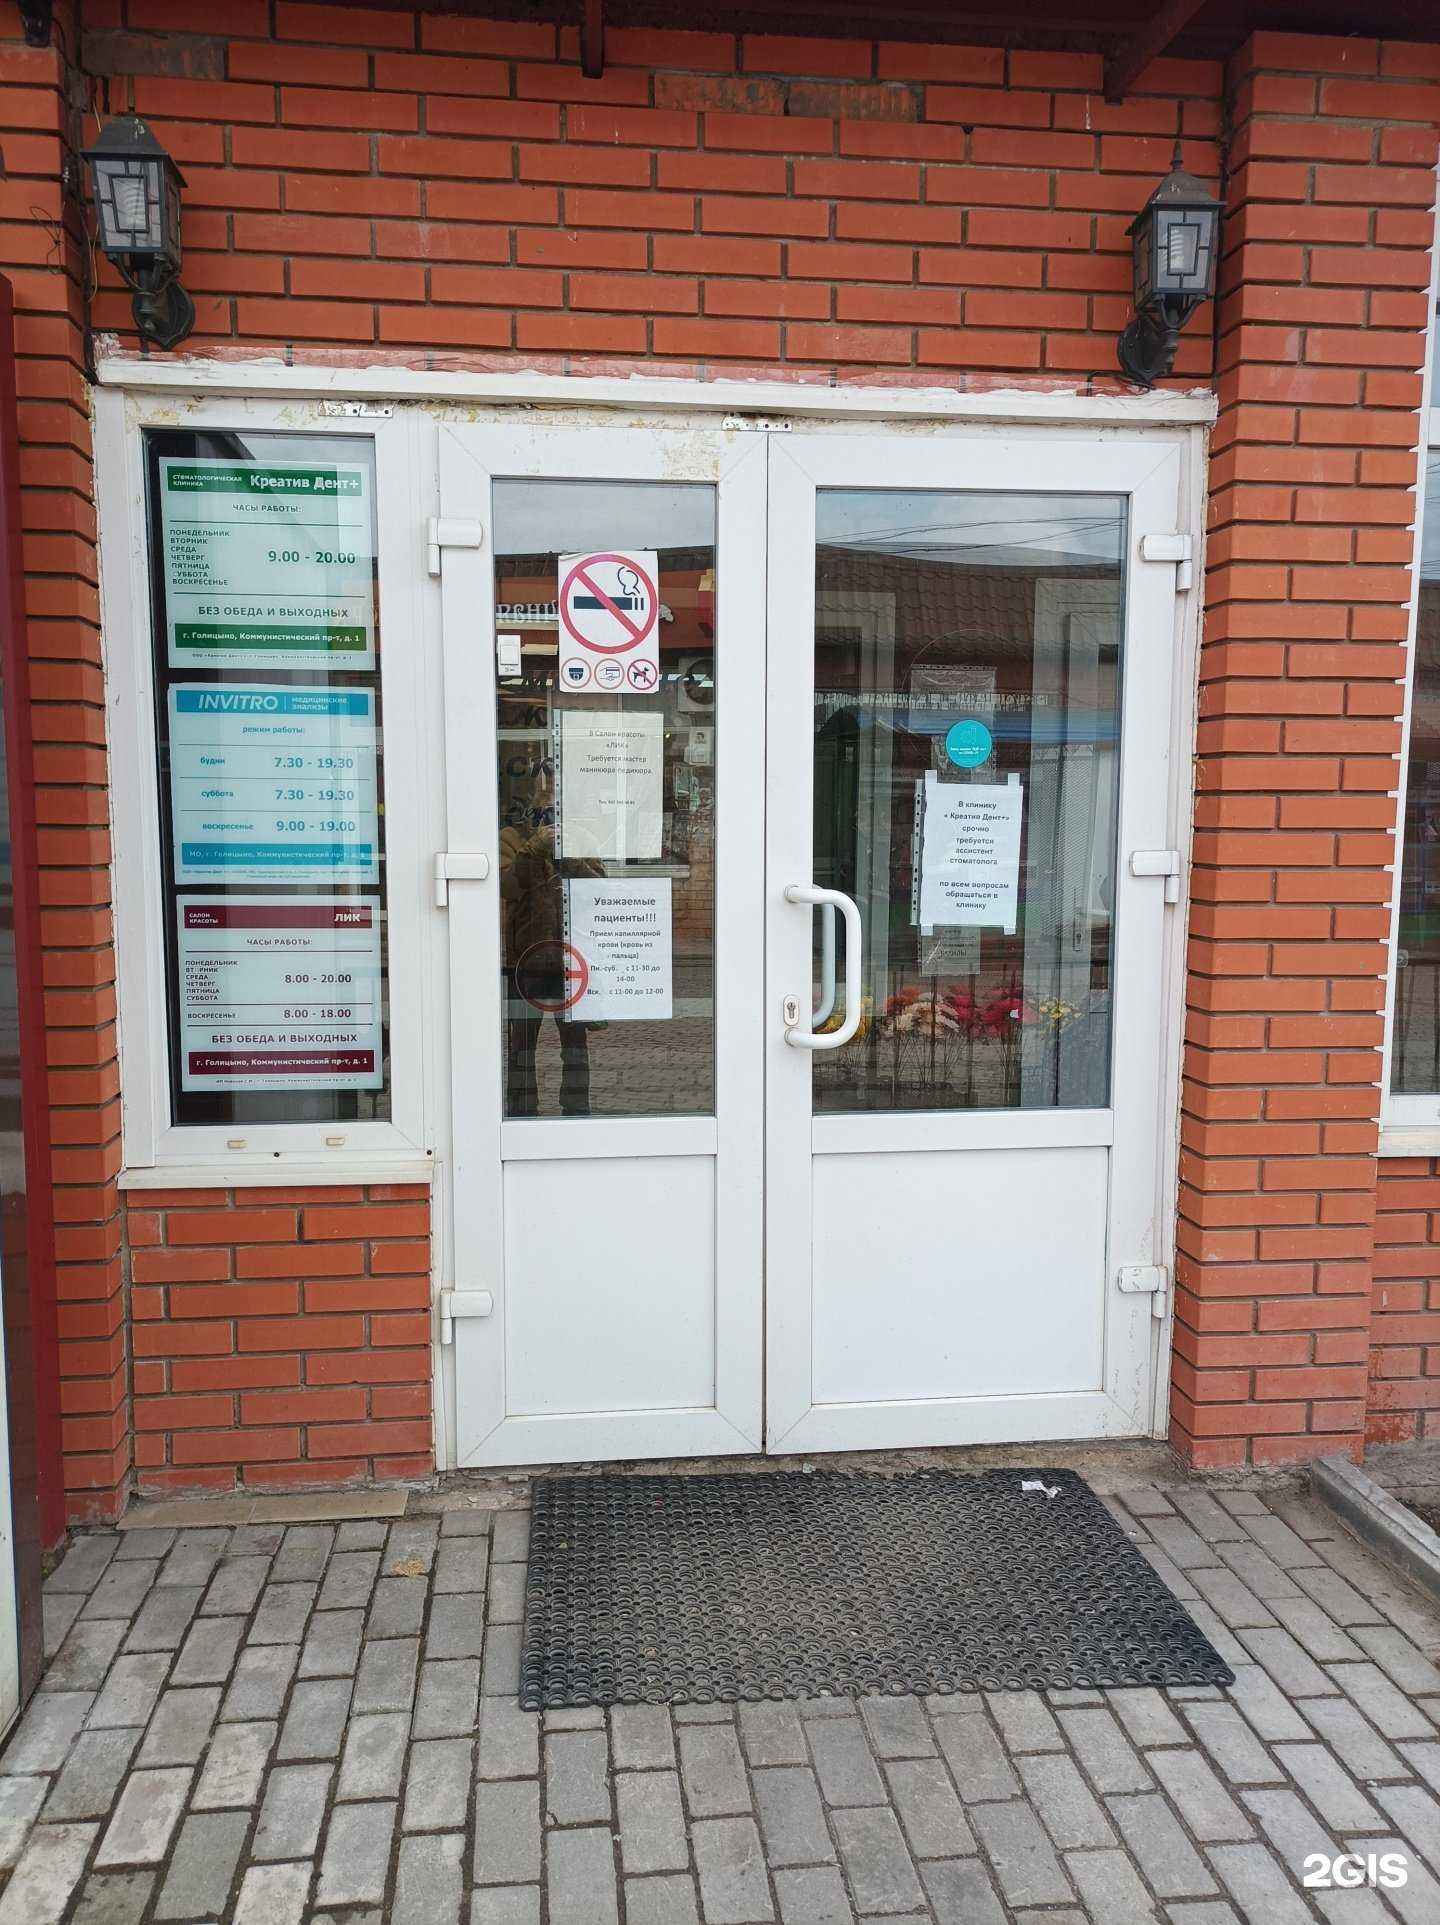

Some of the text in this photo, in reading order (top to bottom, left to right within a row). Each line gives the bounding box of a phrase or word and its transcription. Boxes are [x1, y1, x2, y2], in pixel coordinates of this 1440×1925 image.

[250, 475, 359, 490] Креатив Дент+
[268, 551, 300, 562] 9.00
[315, 552, 356, 564] 20.00
[198, 606, 348, 618] БЕЗ ОБЕДА И ВЫХОДНЫХ
[191, 632, 238, 641] Голицыно,
[239, 633, 320, 642] Коммунистический
[198, 695, 278, 710] INVITRO
[200, 756, 225, 765] будни
[274, 758, 303, 768] 7.30
[318, 758, 353, 768] 19.30
[201, 790, 234, 798] суббота
[275, 790, 304, 800] 7.30
[318, 790, 354, 801] 19.30
[965, 802, 997, 810] клинику
[950, 812, 980, 822] Креатив
[276, 821, 305, 832] 9.00
[319, 821, 355, 832] 19.00
[956, 838, 994, 846] требуется
[972, 882, 1009, 890] вопросам
[945, 891, 992, 899] обращаться
[594, 898, 656, 906] Уважаемые
[956, 902, 986, 910] клинику
[334, 913, 361, 922] ЛИК
[594, 913, 656, 924] пациенты!!!
[284, 974, 309, 983] 8.00
[321, 974, 352, 983] 20.00
[284, 1009, 308, 1018] 8.00
[320, 1009, 352, 1018] 18.00
[212, 1035, 233, 1044] БЕЗ
[236, 1035, 274, 1044] ОБЕДА
[290, 1034, 357, 1044] ВЫХОДНЫХ
[205, 1059, 248, 1068] Голицыно,
[251, 1058, 330, 1067] Коммунистический
